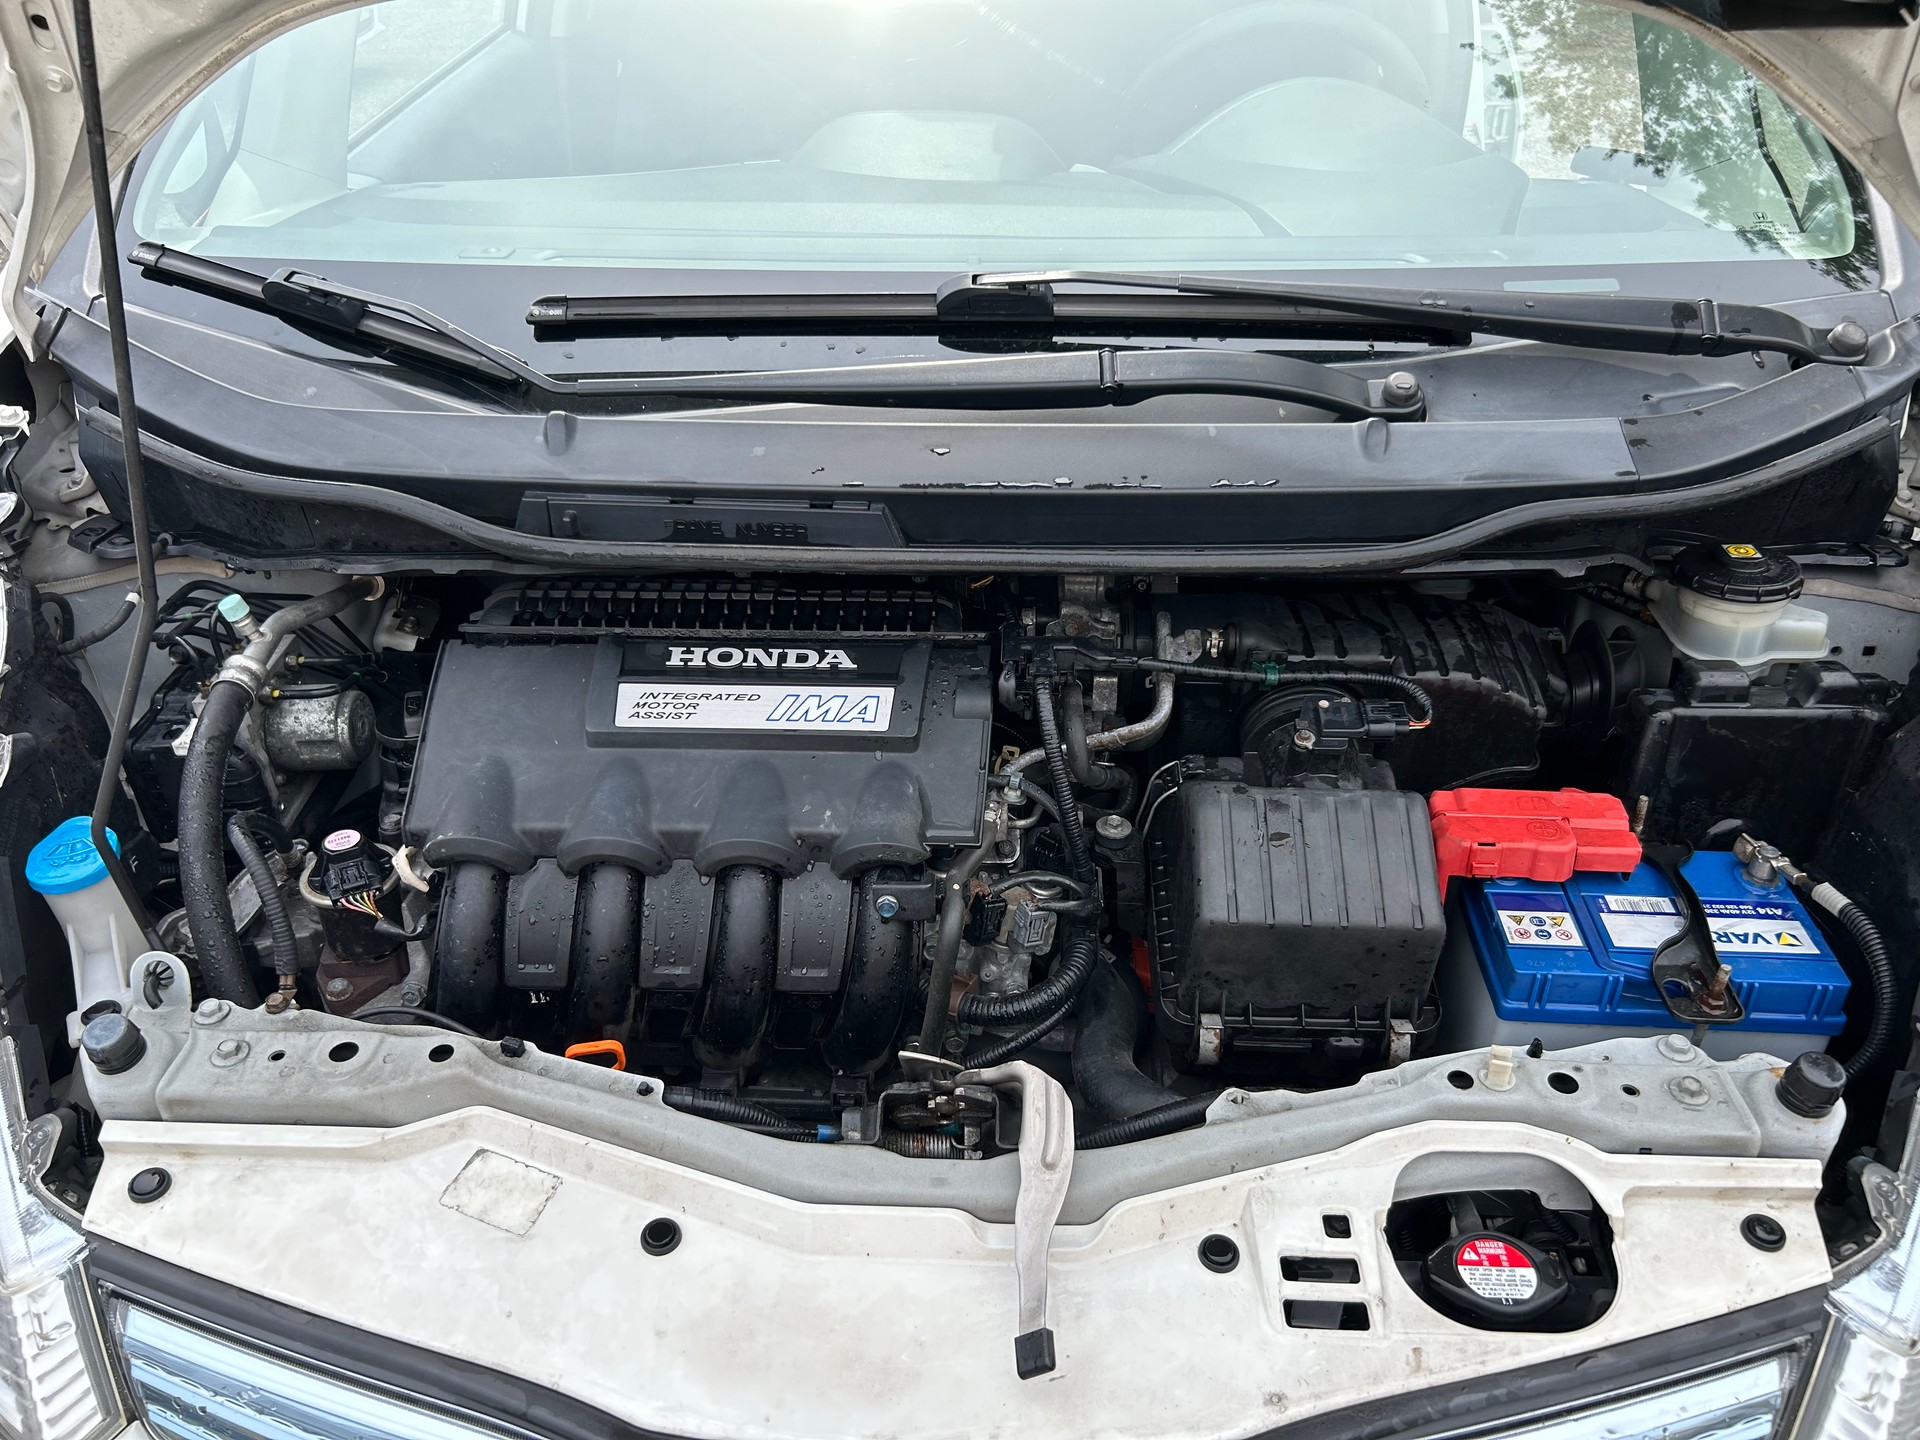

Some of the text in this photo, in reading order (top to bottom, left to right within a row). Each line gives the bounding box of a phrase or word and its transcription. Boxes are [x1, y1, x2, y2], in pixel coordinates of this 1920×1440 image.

[664, 519, 808, 538] FRAME NUMBER
[665, 646, 858, 669] HONDA
[632, 702, 700, 710] MOTOR
[639, 692, 880, 724] INTEGRATED IMA
[628, 712, 697, 720] ASSIST
[1756, 907, 1783, 916] A14
[1710, 930, 1773, 944] VAR
